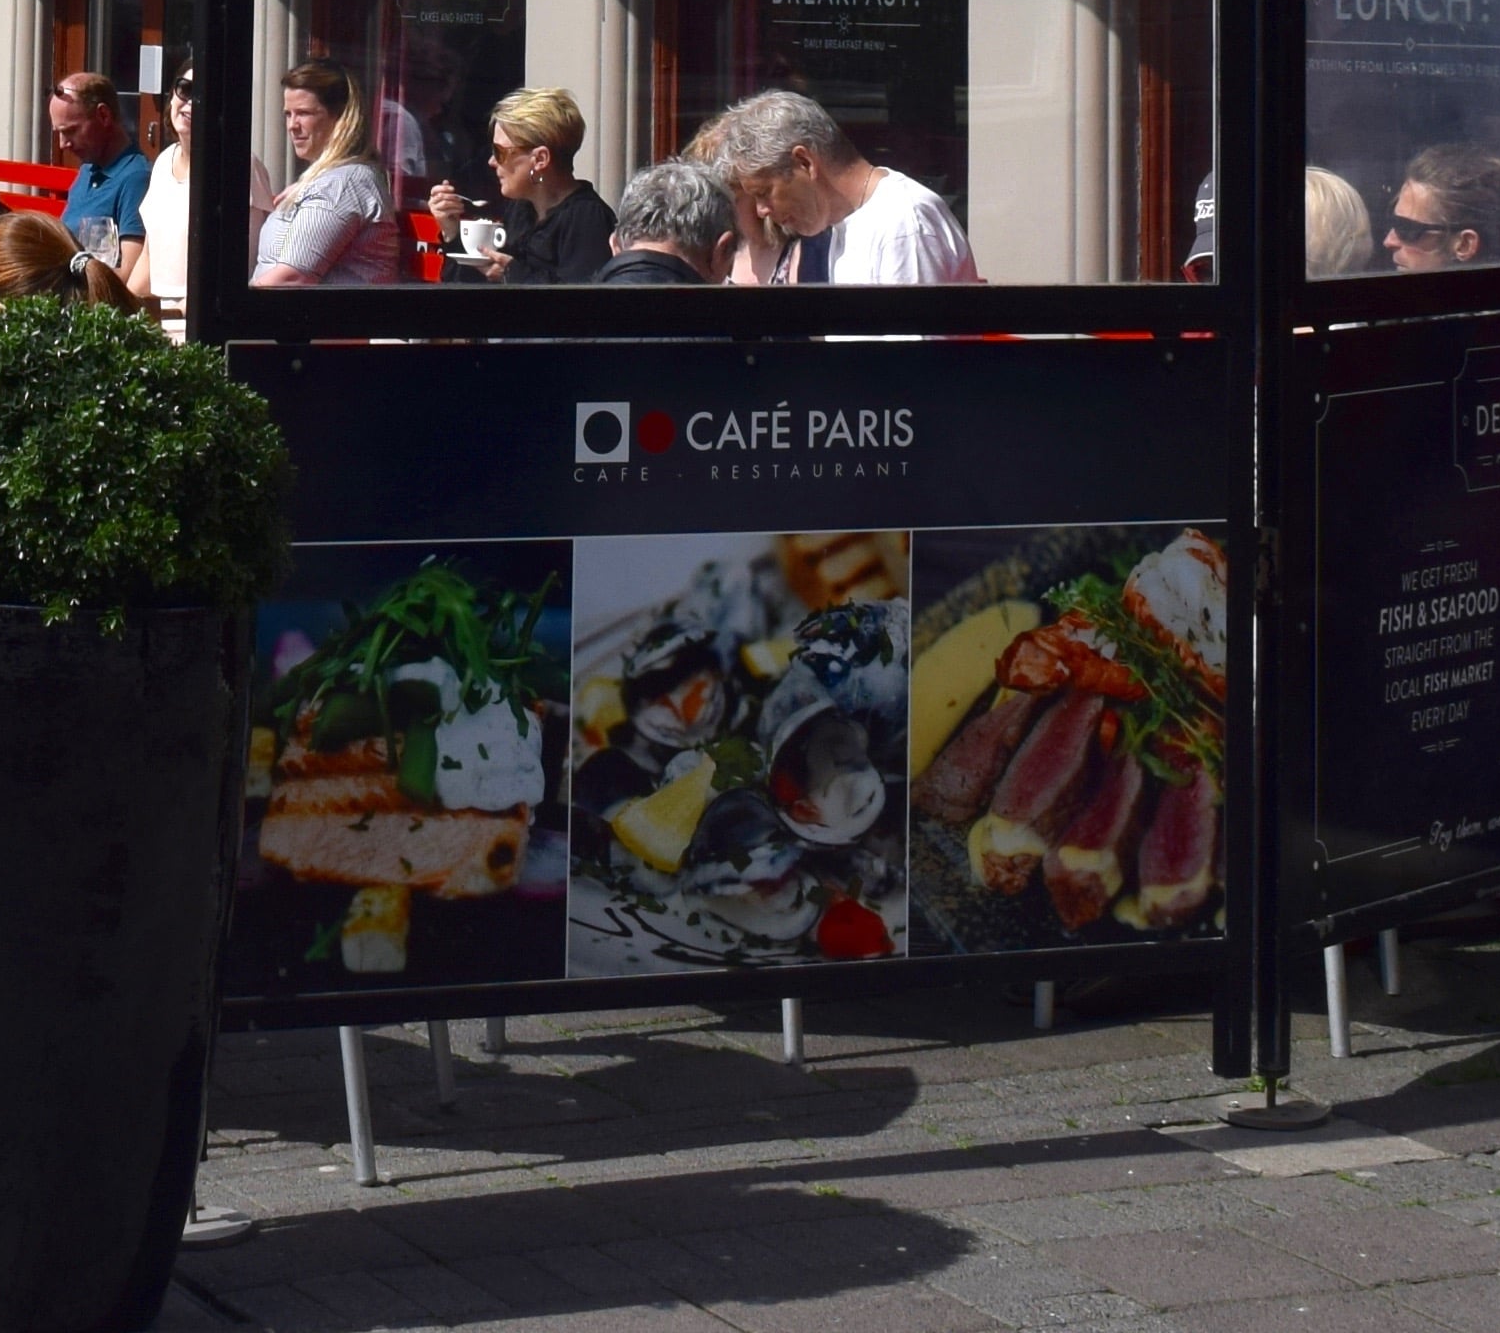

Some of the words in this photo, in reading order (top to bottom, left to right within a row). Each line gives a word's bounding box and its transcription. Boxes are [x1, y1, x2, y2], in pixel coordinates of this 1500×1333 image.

[686, 400, 792, 451] CAFÉ
[808, 408, 914, 449] PARIS
[573, 466, 650, 483] CAFE
[711, 461, 910, 481] RESTAURANT
[1401, 570, 1419, 592] WE
[1420, 565, 1441, 589] GET
[1443, 558, 1479, 585] FRESH
[1378, 601, 1414, 635] FISH
[1416, 600, 1427, 627] &
[1429, 586, 1500, 626] SEAFOOD
[1384, 637, 1439, 669] STRAIGHT
[1439, 631, 1472, 657] FROM
[1473, 626, 1495, 651] THE
[1384, 676, 1422, 704] LOCAL
[1423, 669, 1449, 695] FISH
[1449, 659, 1496, 688] MARKET
[1411, 703, 1447, 732] EVERY
[1447, 697, 1471, 724] DAY
